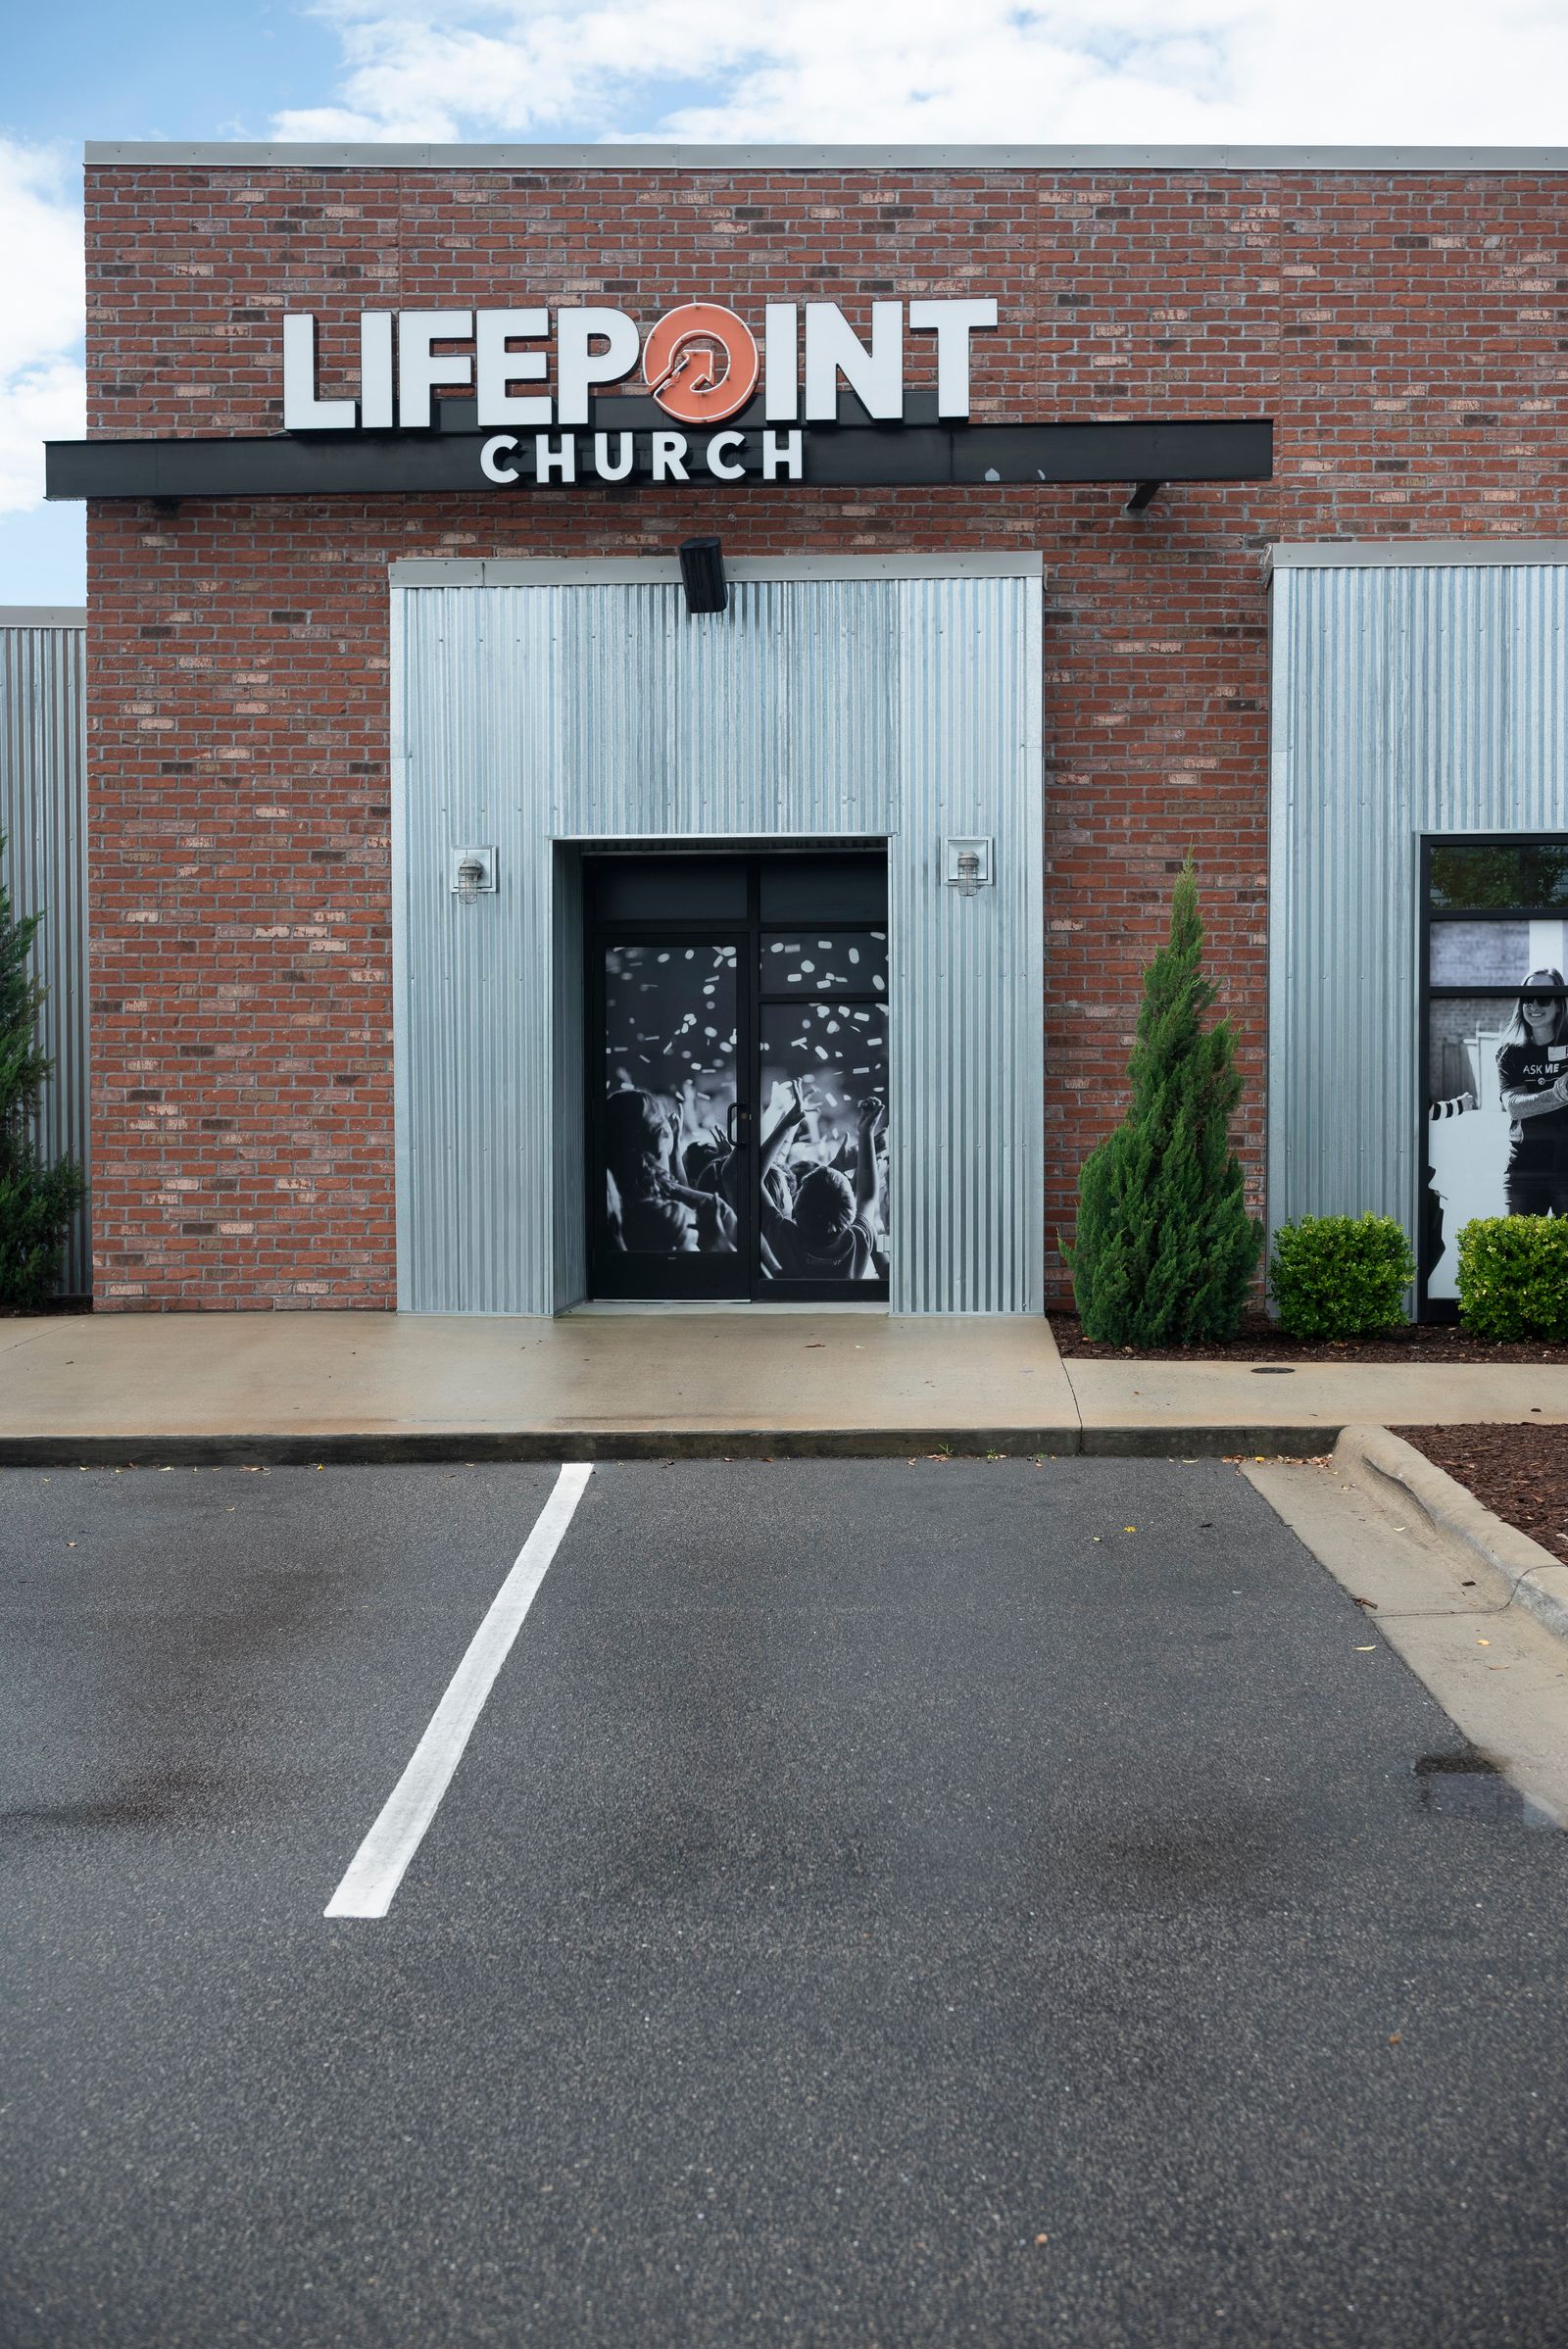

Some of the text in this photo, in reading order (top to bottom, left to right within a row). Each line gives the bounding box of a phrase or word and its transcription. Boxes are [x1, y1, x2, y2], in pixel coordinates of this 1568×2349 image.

[282, 298, 998, 429] LIFEPOINT
[480, 429, 803, 484] CHURCH
[1522, 1063, 1559, 1075] ASK ME
